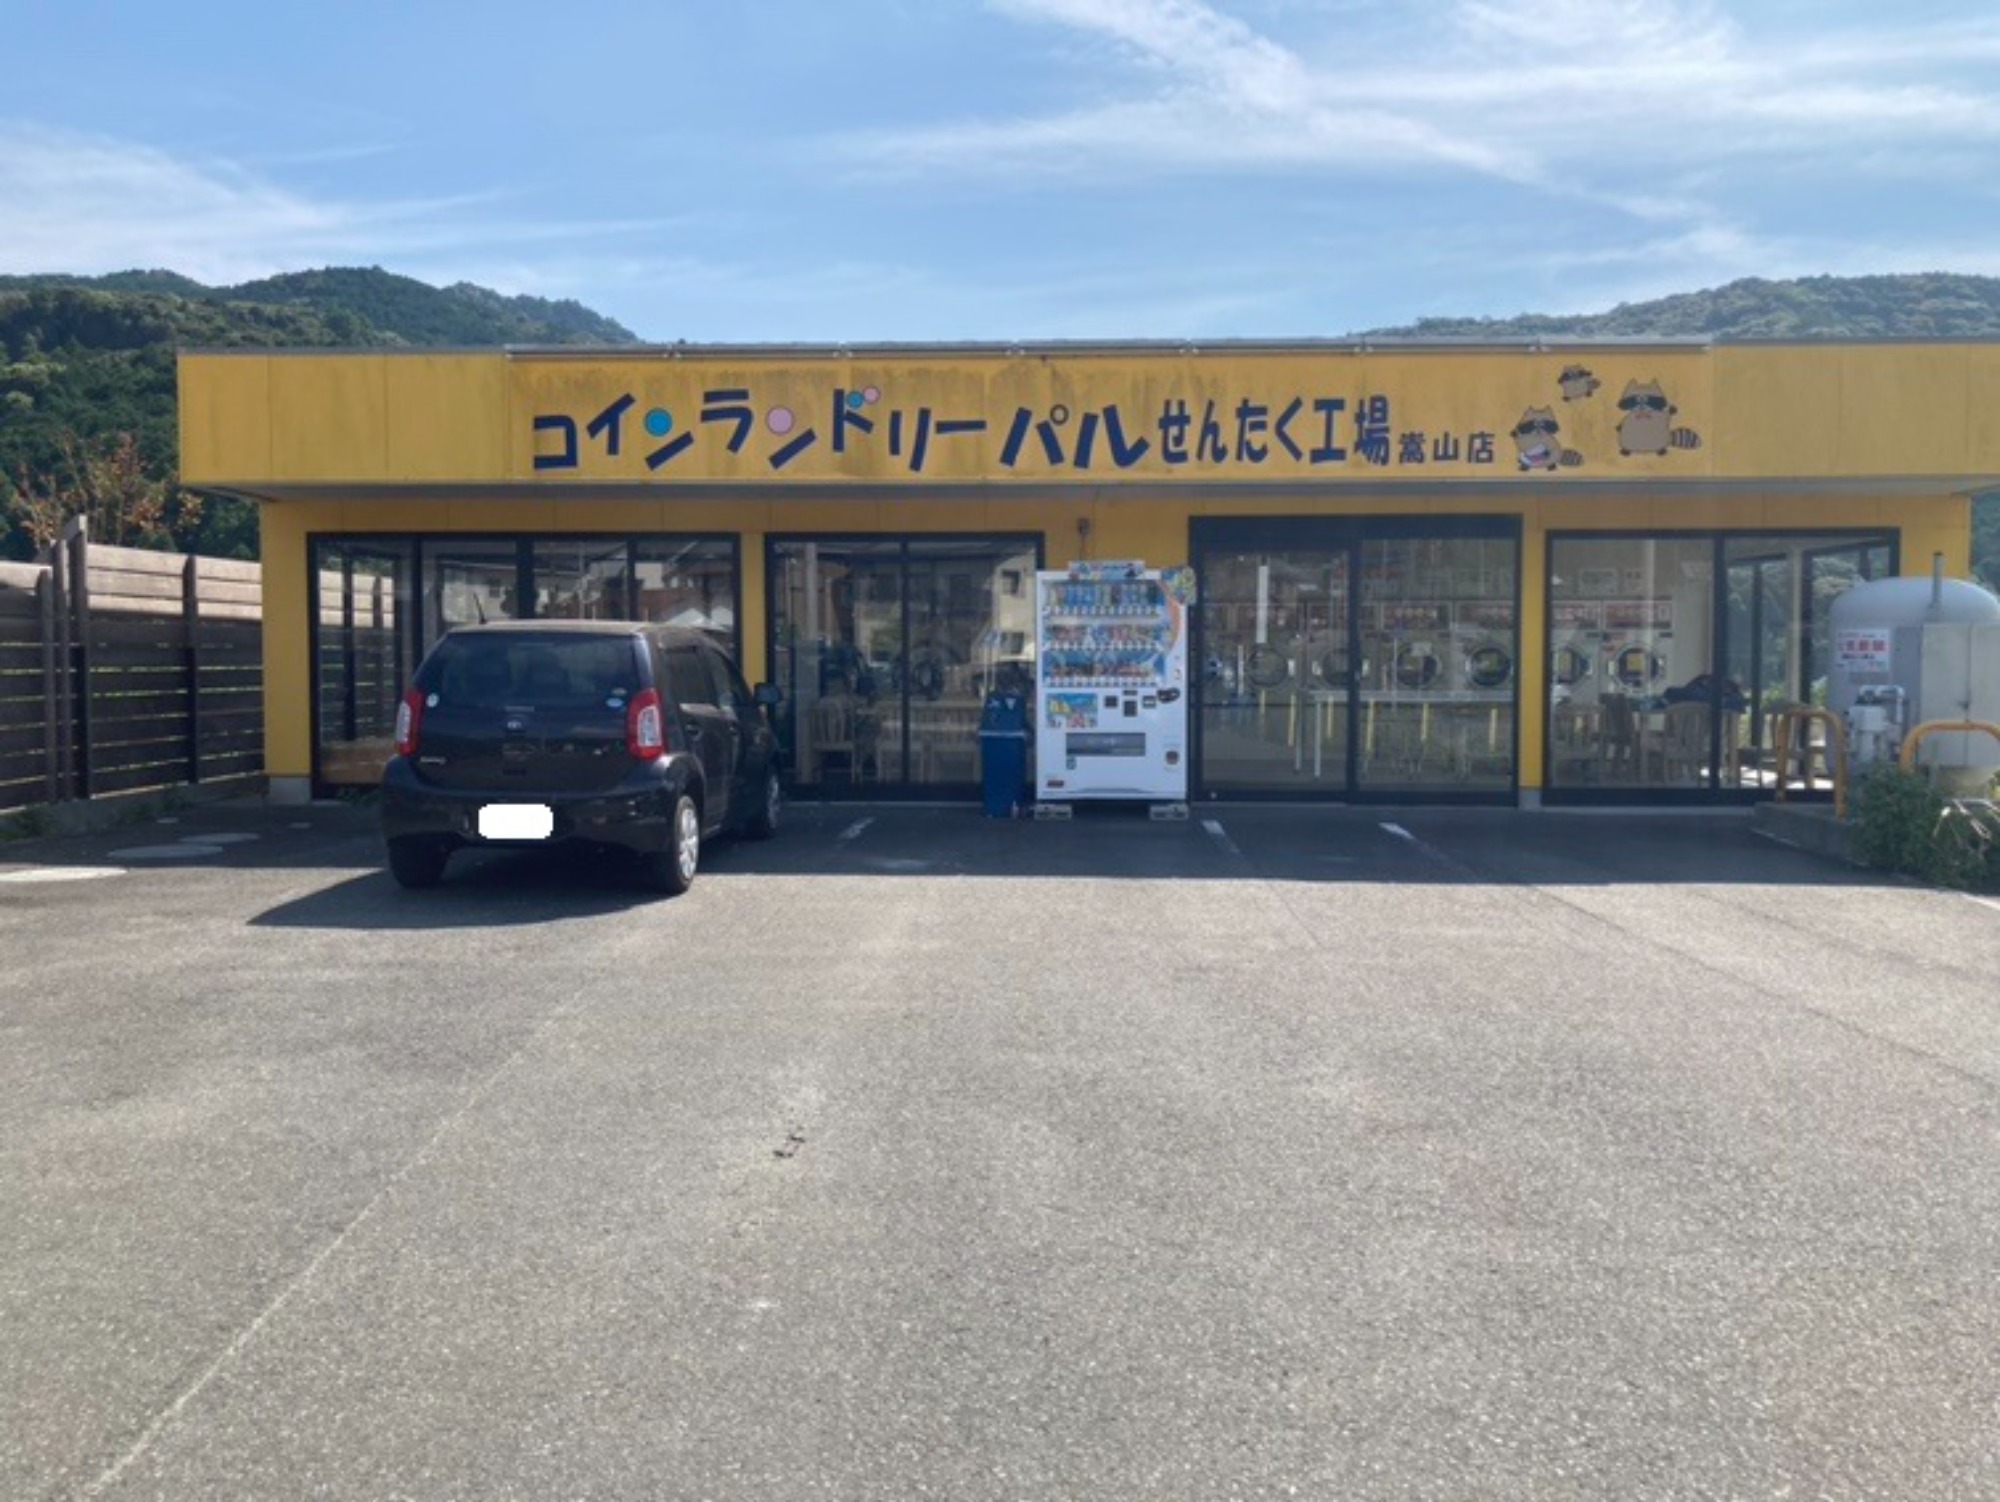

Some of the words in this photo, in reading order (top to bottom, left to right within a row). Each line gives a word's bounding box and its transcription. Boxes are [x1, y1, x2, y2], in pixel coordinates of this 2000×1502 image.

[1158, 395, 1390, 466] せんたく工場
[1398, 431, 1495, 464] 嵩山店
